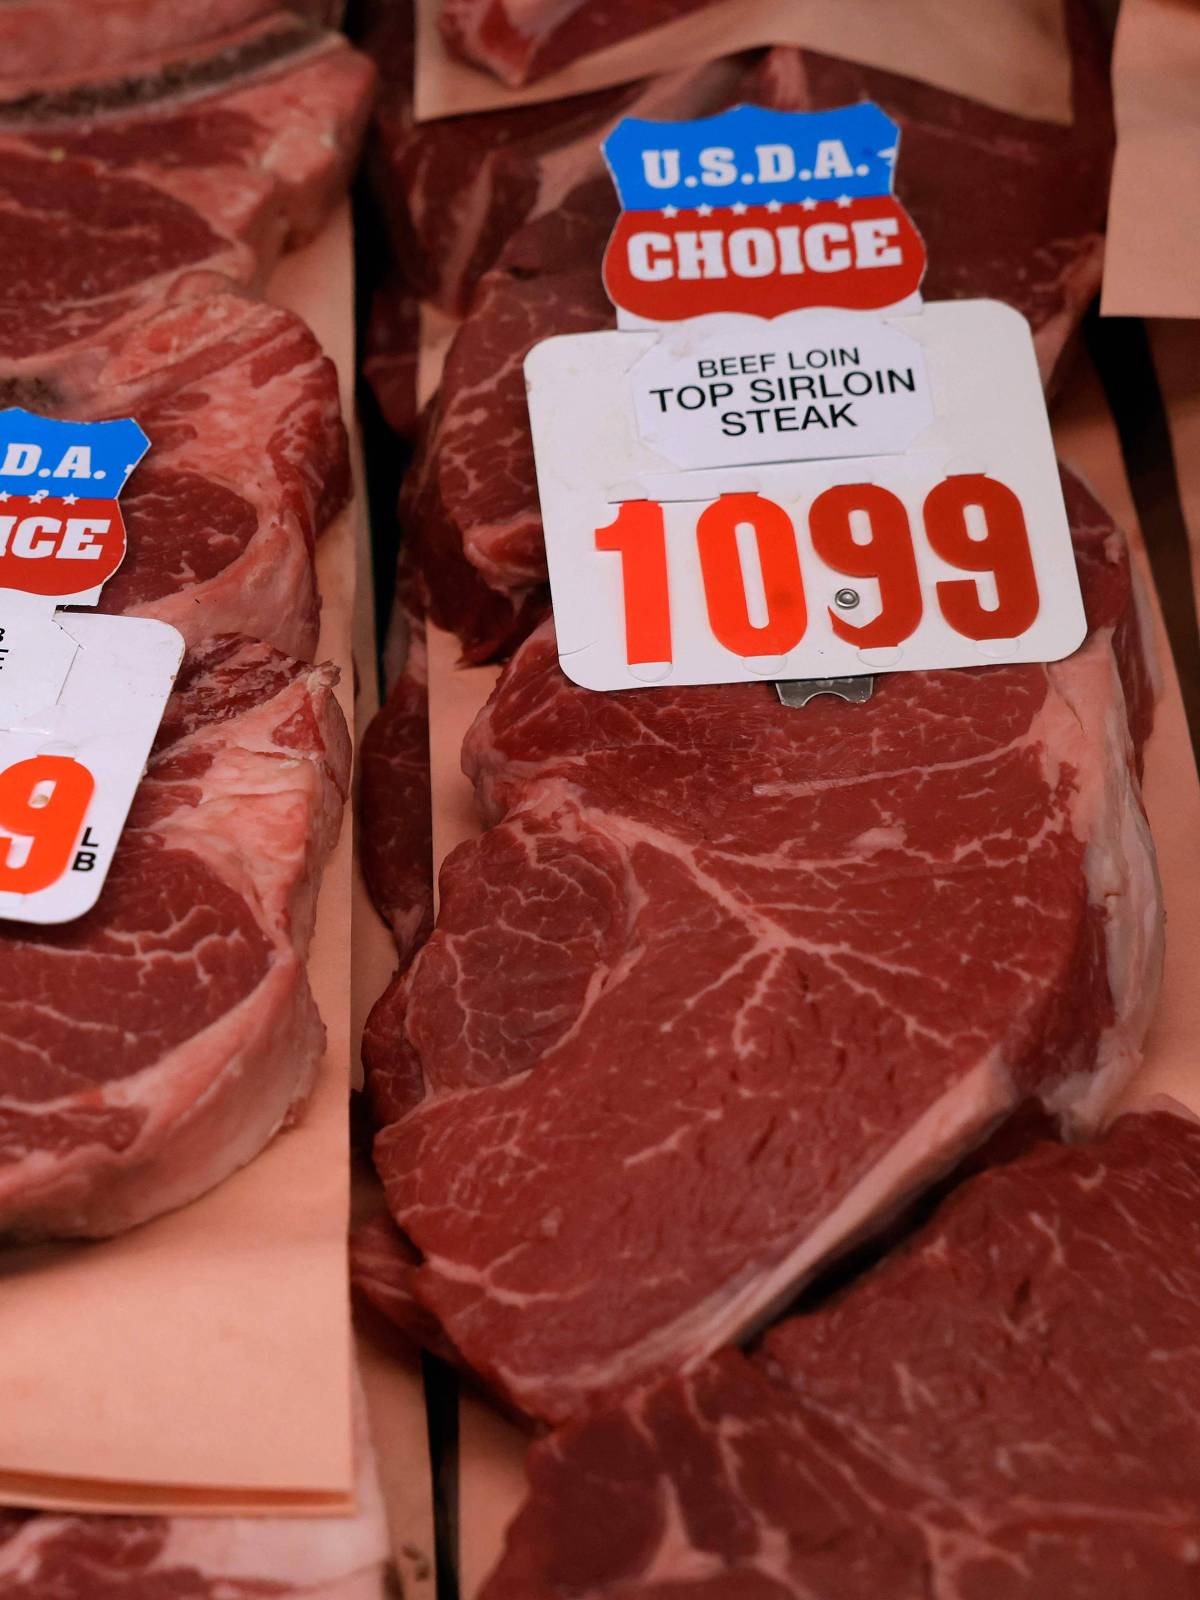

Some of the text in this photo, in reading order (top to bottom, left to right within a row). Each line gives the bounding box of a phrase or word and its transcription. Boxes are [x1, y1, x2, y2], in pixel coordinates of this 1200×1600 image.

[642, 140, 870, 189] U.S.D.A.
[627, 217, 903, 282] CHOICE
[698, 347, 860, 379] BEEF LOIN
[649, 368, 916, 413] TOP SIRLOIN
[721, 403, 858, 437] STEAK
